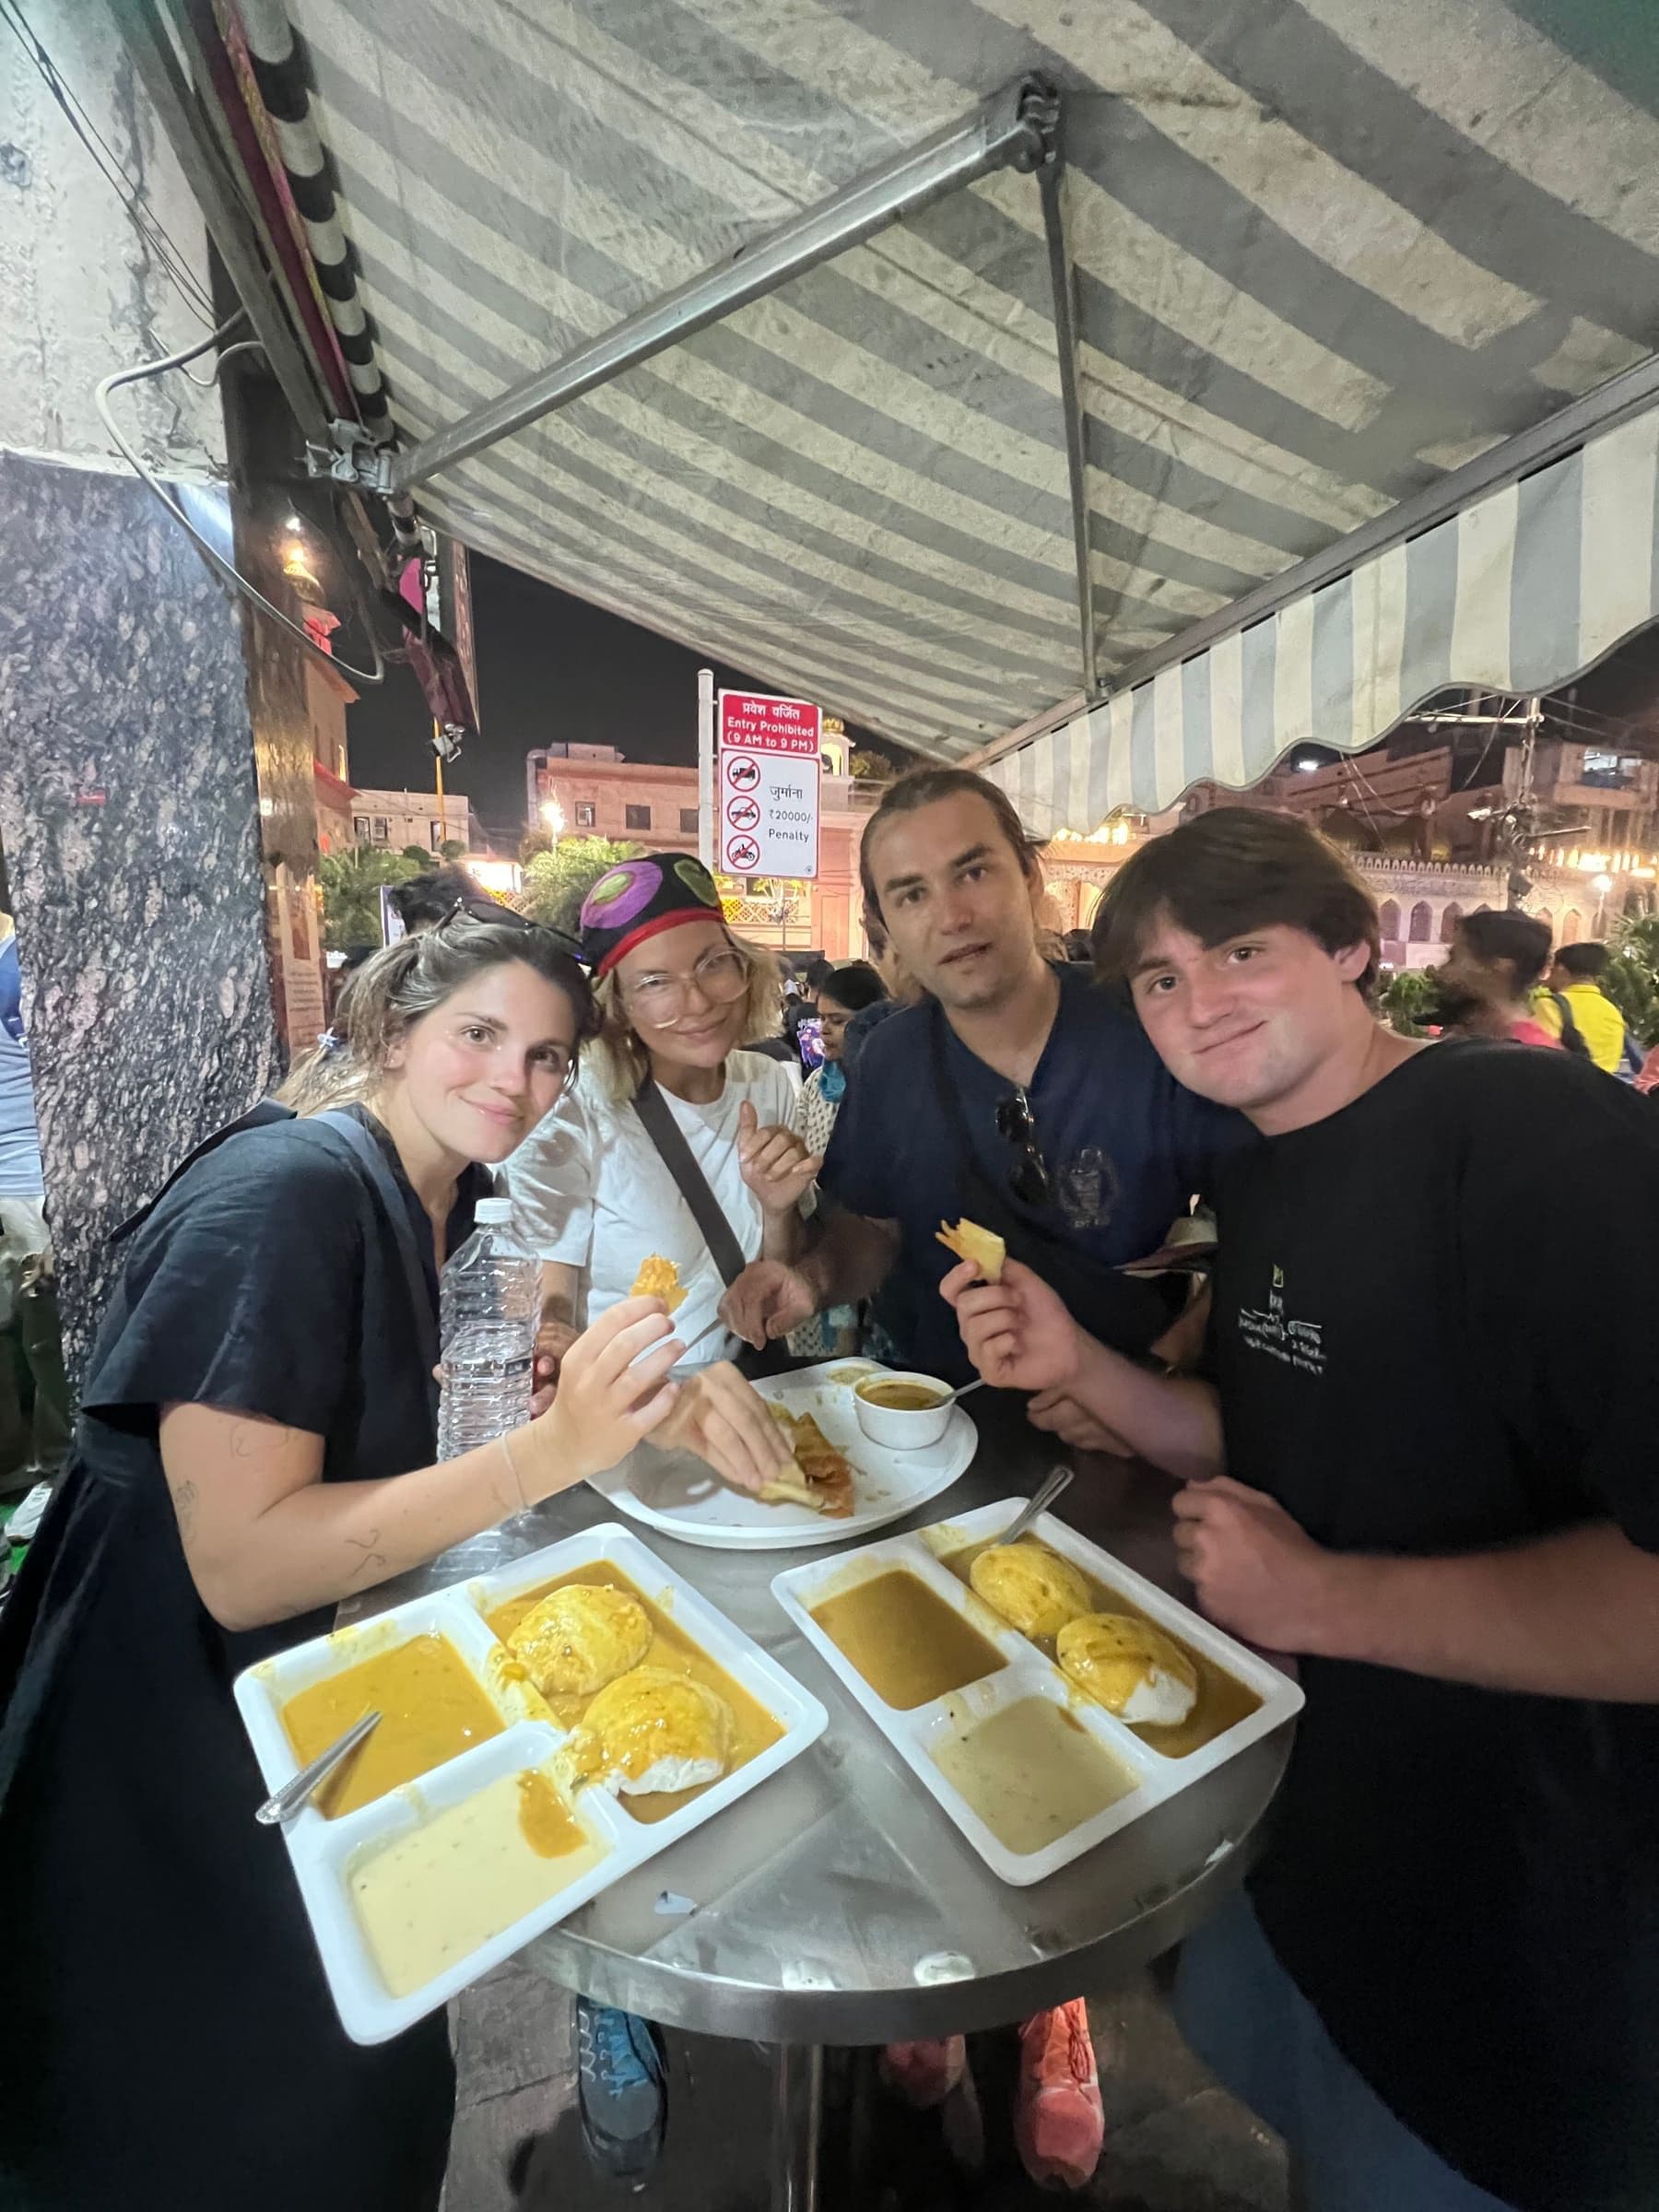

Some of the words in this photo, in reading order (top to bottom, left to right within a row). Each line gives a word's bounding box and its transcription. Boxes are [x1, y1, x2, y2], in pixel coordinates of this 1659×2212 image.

[742, 700, 766, 716] प्रवेश
[771, 703, 800, 721] वर्जित
[727, 716, 757, 731] Entry
[759, 721, 814, 737] Prohibited
[727, 730, 741, 743] (9
[745, 734, 762, 746] AM
[766, 737, 777, 747] to
[781, 737, 788, 748] 9
[792, 739, 814, 752] PM)
[769, 784, 803, 802] जुर्माना
[769, 828, 809, 843] Penalty
